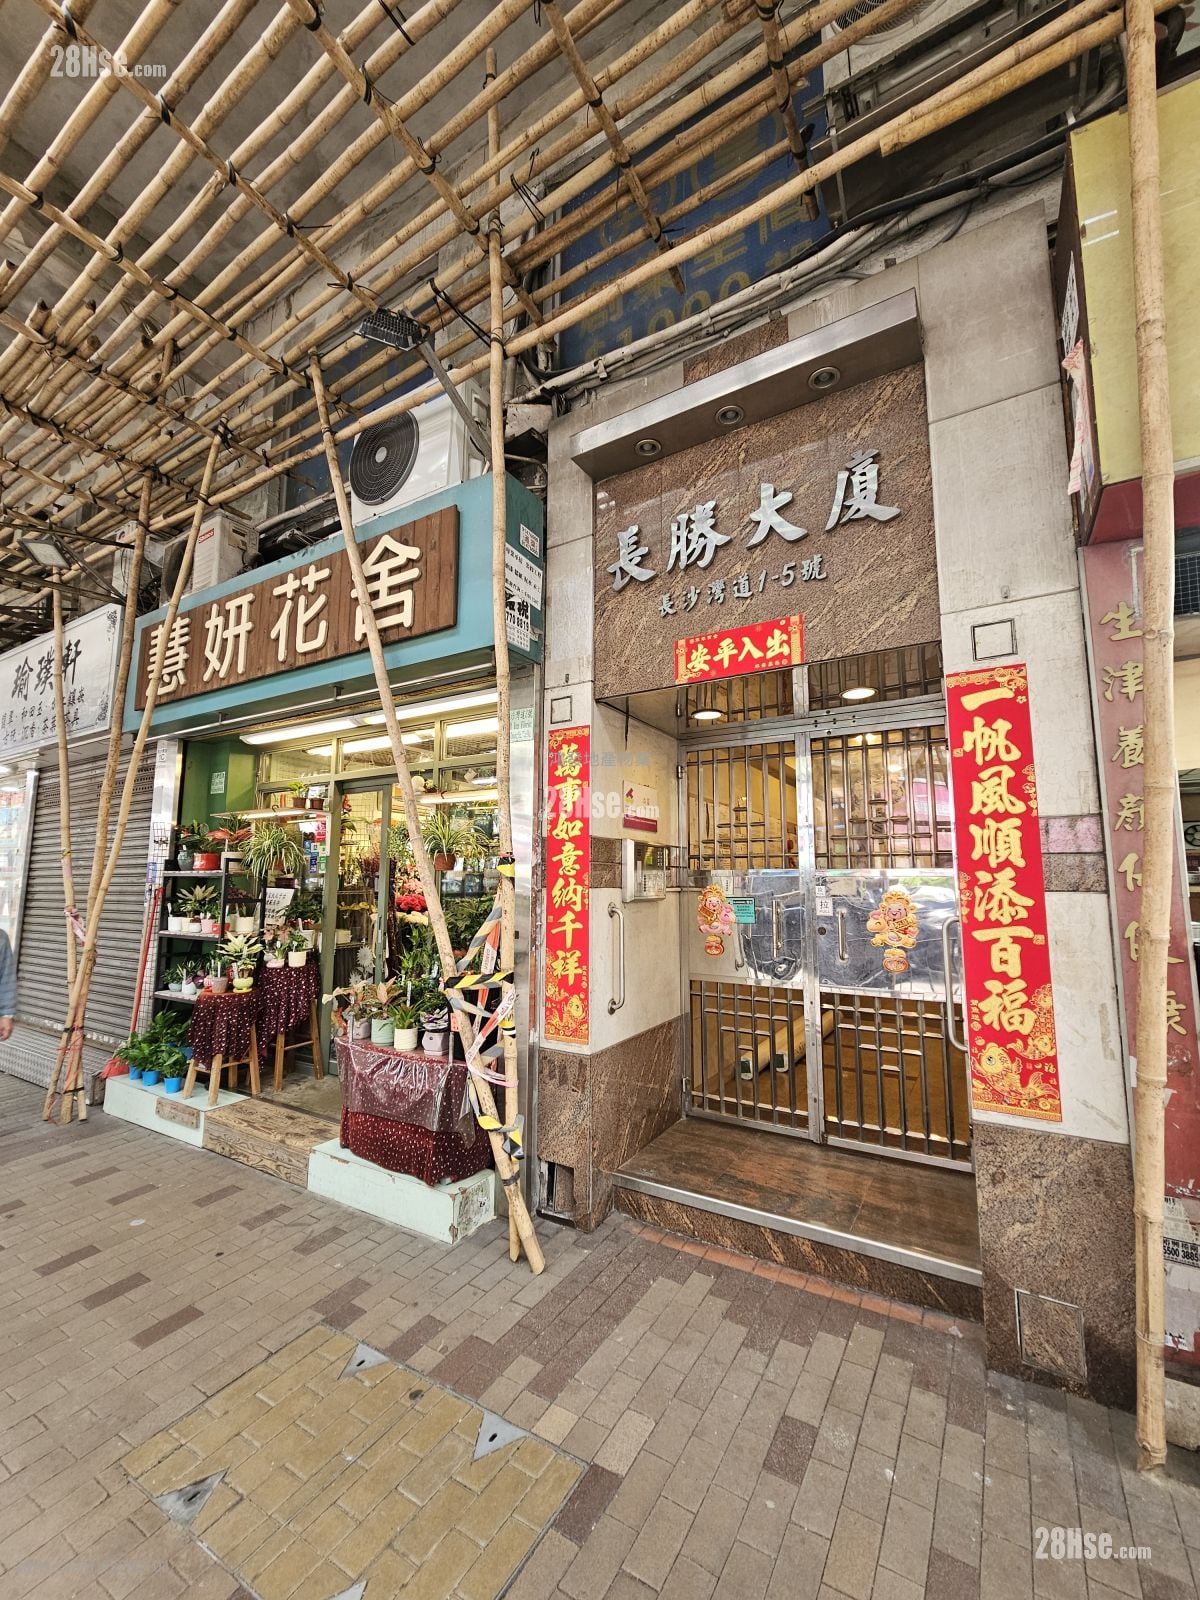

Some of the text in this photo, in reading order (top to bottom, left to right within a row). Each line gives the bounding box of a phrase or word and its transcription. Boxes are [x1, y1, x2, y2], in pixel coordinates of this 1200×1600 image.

[607, 449, 901, 591] 長勝大廈
[658, 553, 827, 617] 長沙灣道1-5號
[146, 534, 422, 696] 慧妍花舍
[551, 742, 583, 986] 萬事如意納千祥
[960, 687, 1037, 1036] 一帆風順添百福
